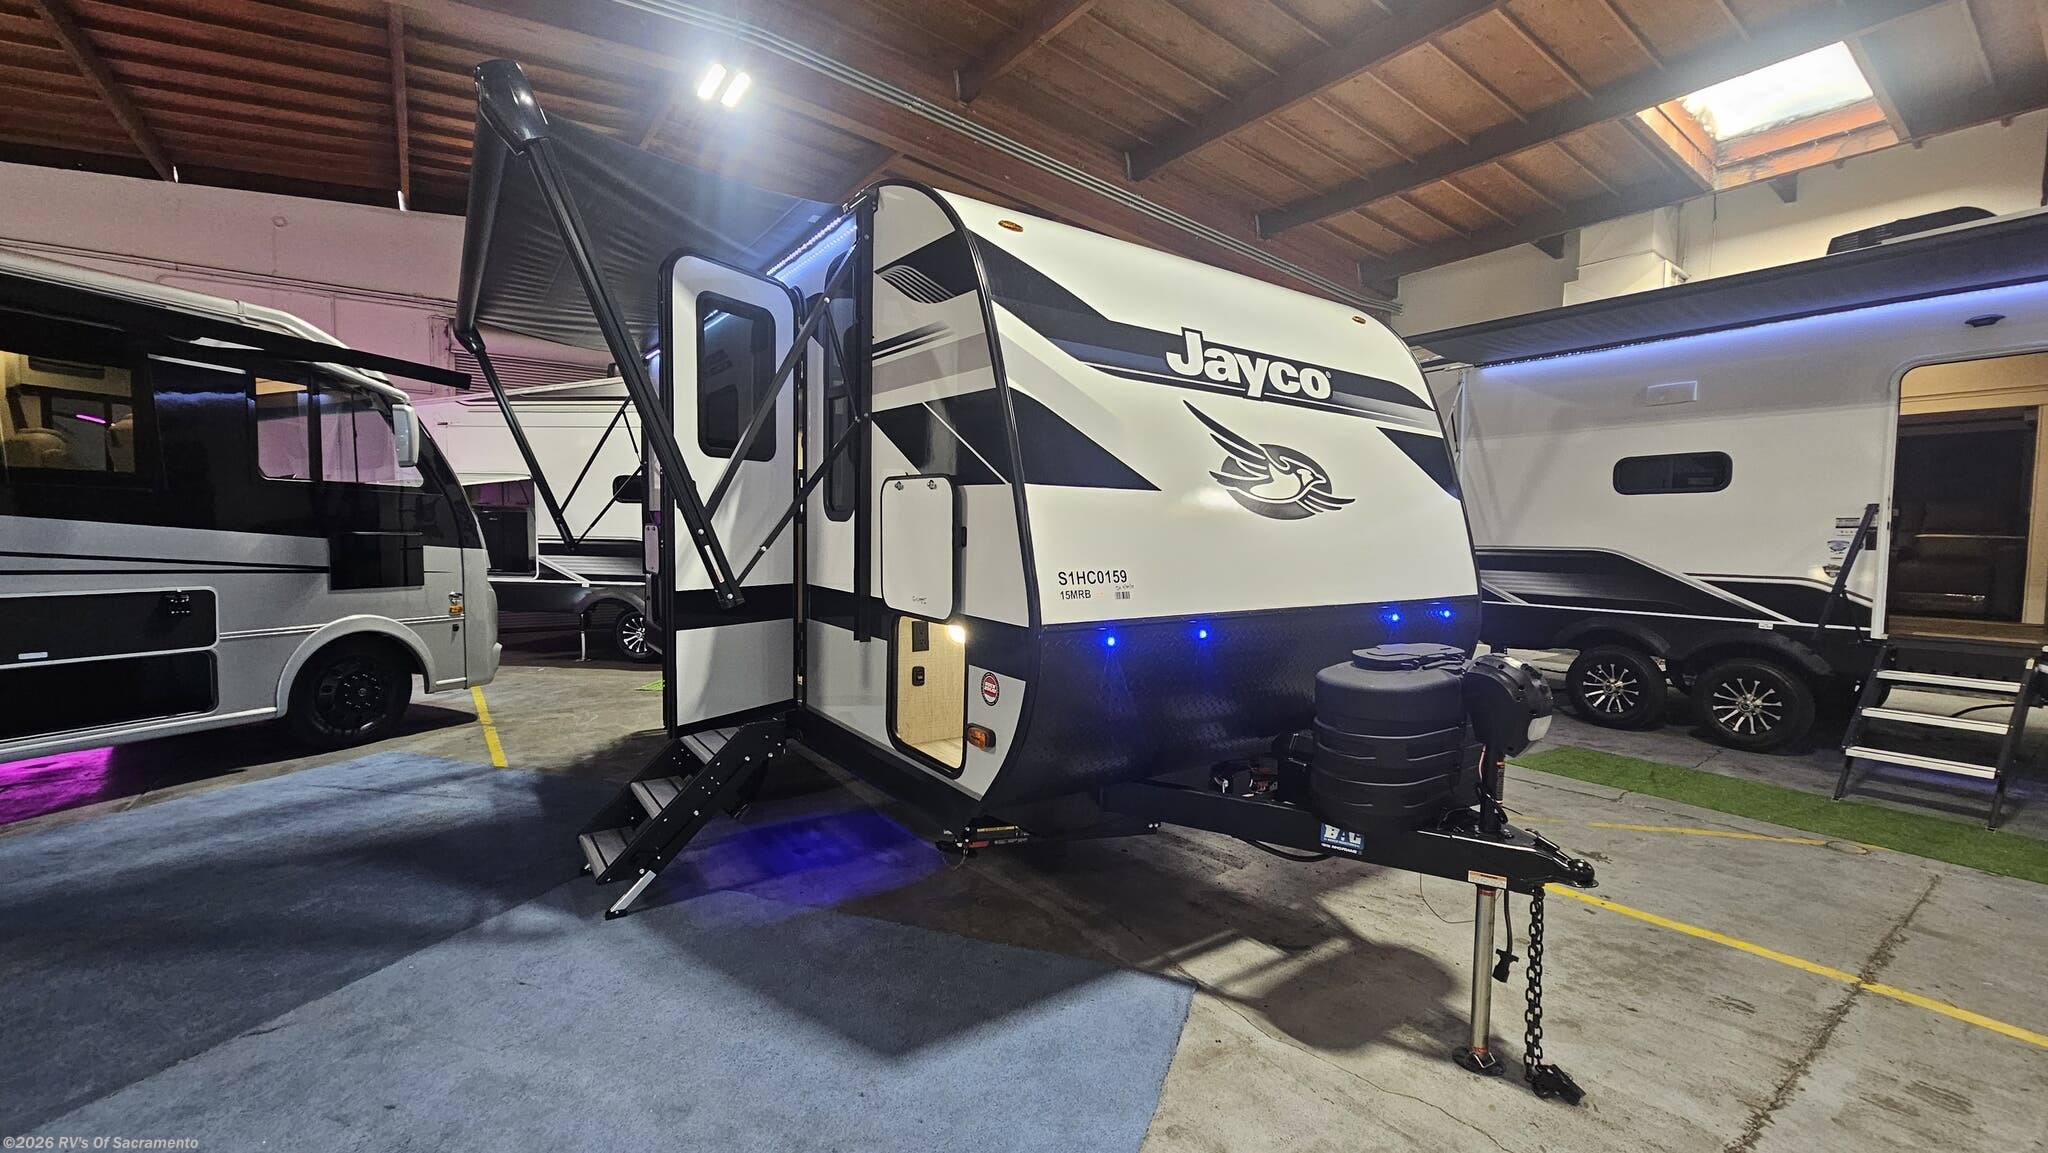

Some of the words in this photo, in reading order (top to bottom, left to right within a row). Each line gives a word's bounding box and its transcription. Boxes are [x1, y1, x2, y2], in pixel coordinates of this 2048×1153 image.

[1166, 330, 1331, 399] Jayco
[1058, 569, 1127, 586] S1HC0159
[1060, 589, 1092, 600] 15MRB
